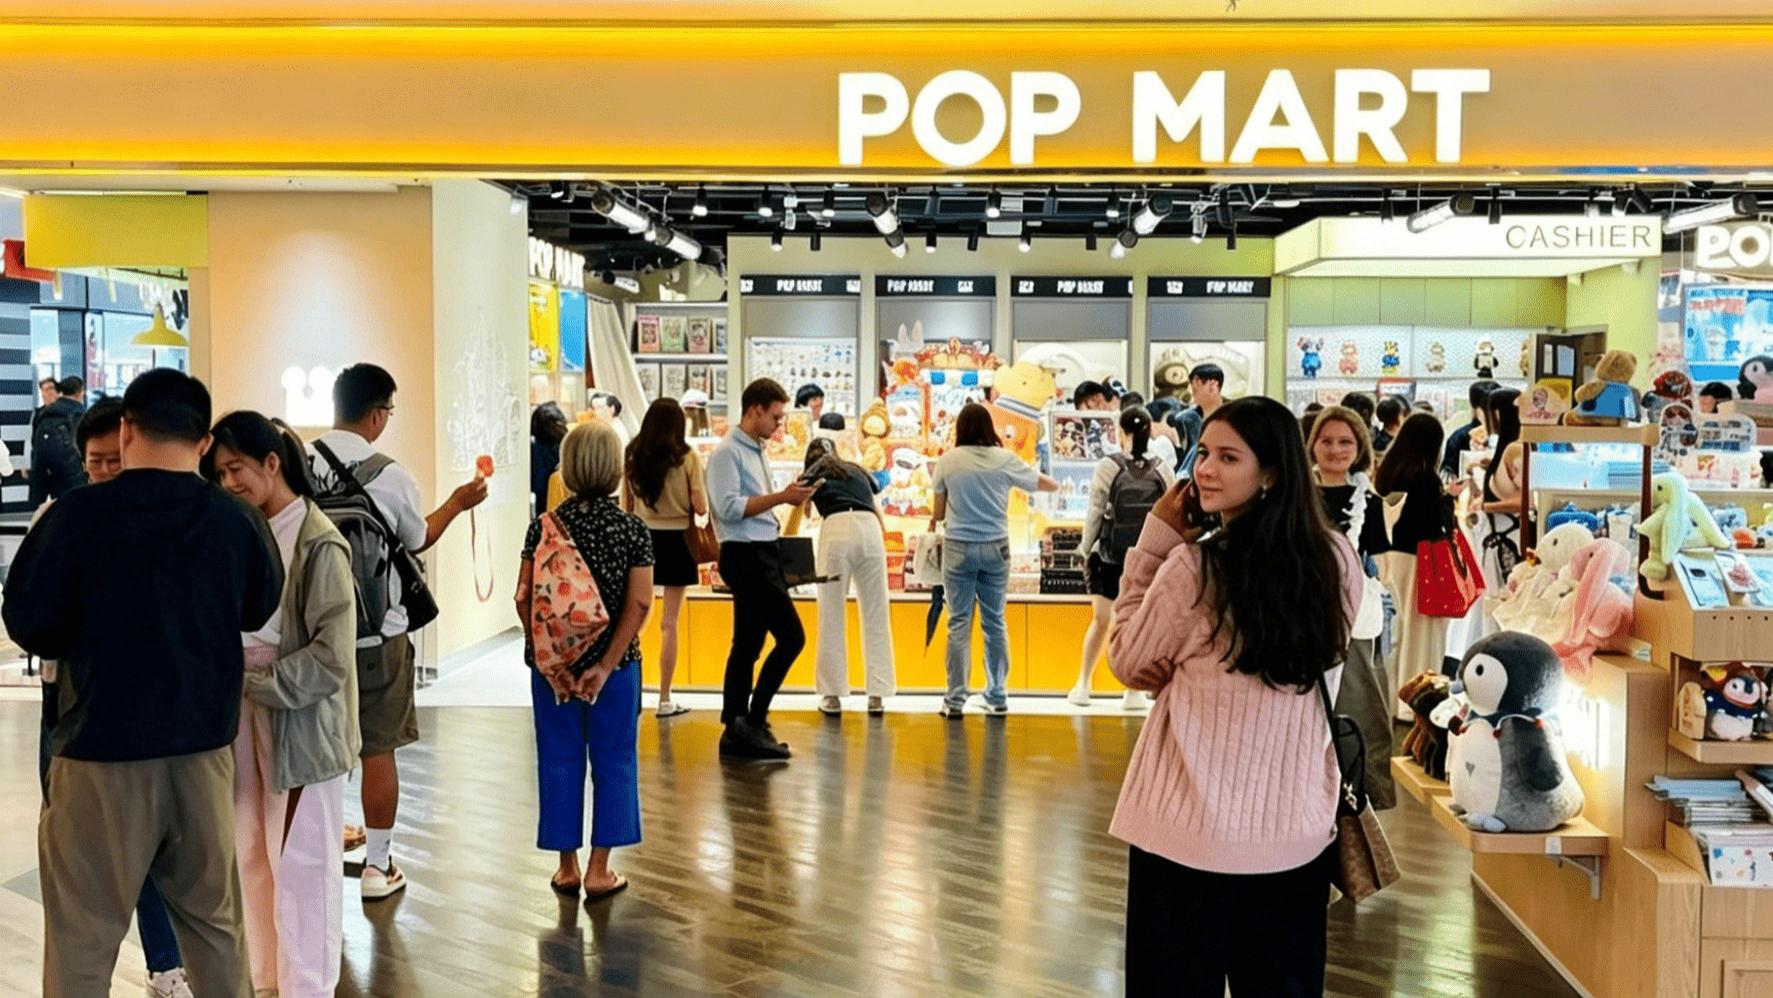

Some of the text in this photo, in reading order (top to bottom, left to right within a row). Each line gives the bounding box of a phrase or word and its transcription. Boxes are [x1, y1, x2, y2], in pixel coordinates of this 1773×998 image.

[838, 69, 1490, 166] POP MART
[1506, 225, 1651, 249] CASHIER
[1697, 225, 1773, 269] PO
